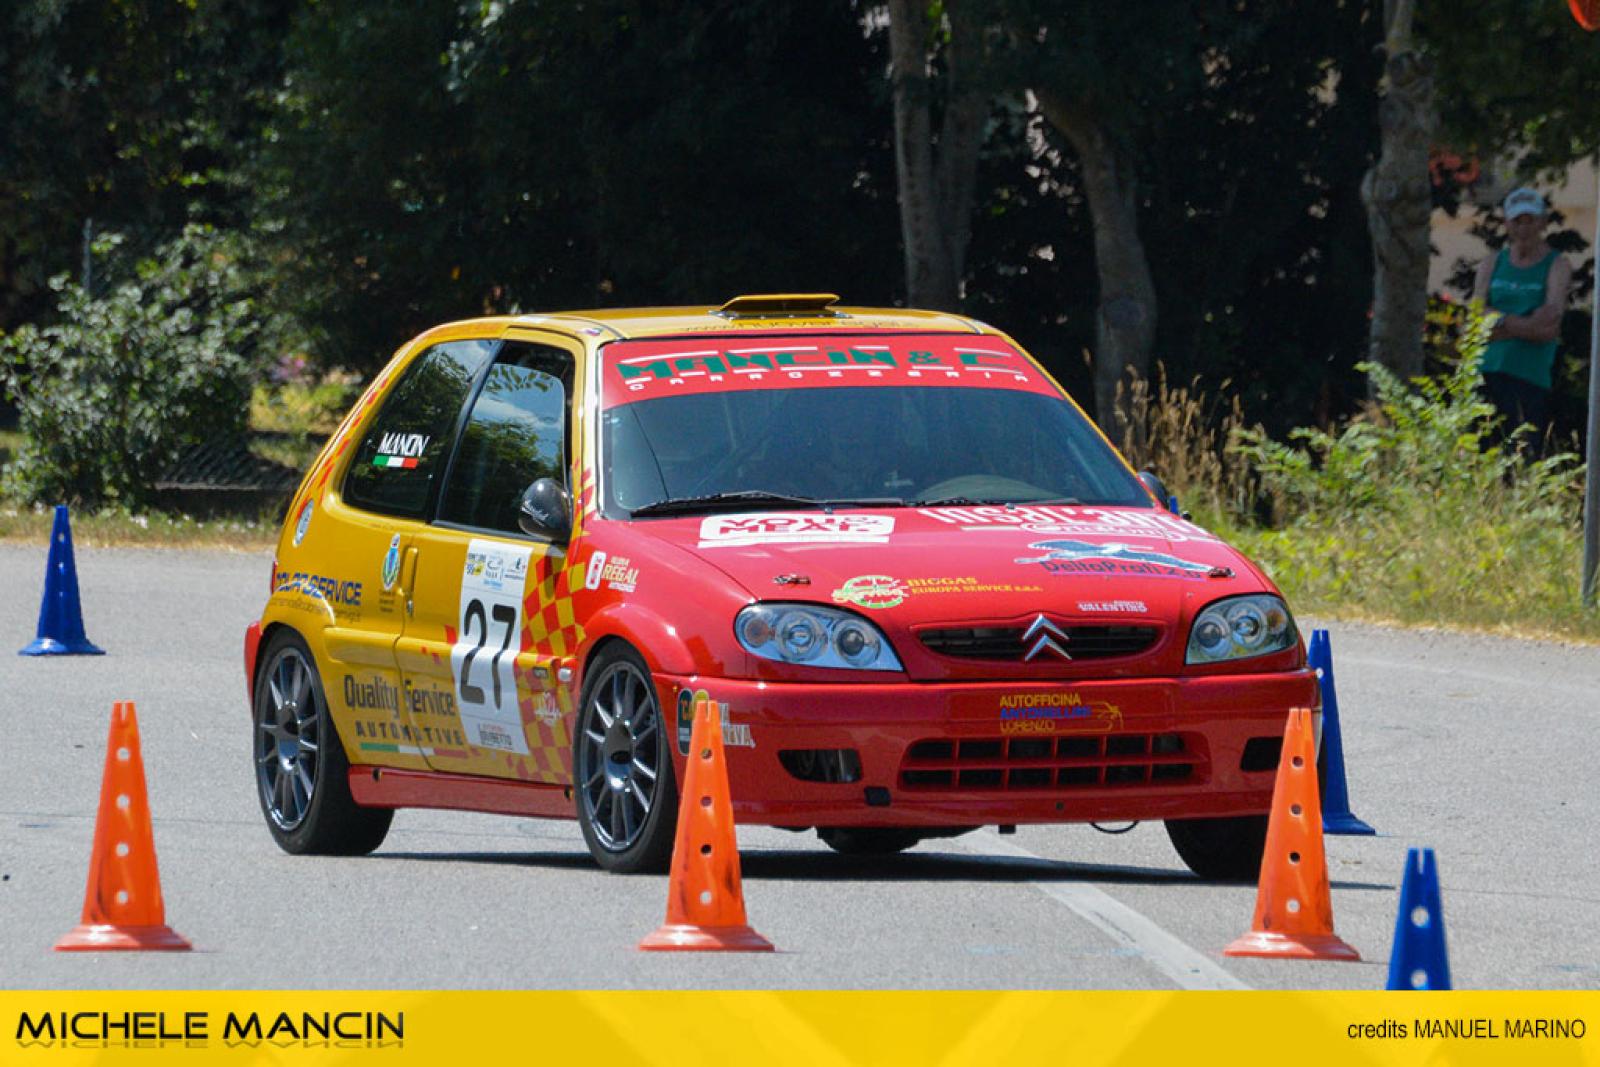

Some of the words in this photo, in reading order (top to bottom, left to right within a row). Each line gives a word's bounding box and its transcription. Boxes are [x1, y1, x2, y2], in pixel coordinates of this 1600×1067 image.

[616, 348, 898, 379] MANCIN
[908, 351, 941, 364] &
[602, 563, 639, 585] REGAL
[460, 598, 518, 712] 27
[344, 674, 399, 718] Quality
[404, 680, 456, 717] Service
[1000, 693, 1081, 707] AUTOFFICINA
[355, 720, 465, 747] AUTOMOTIVE
